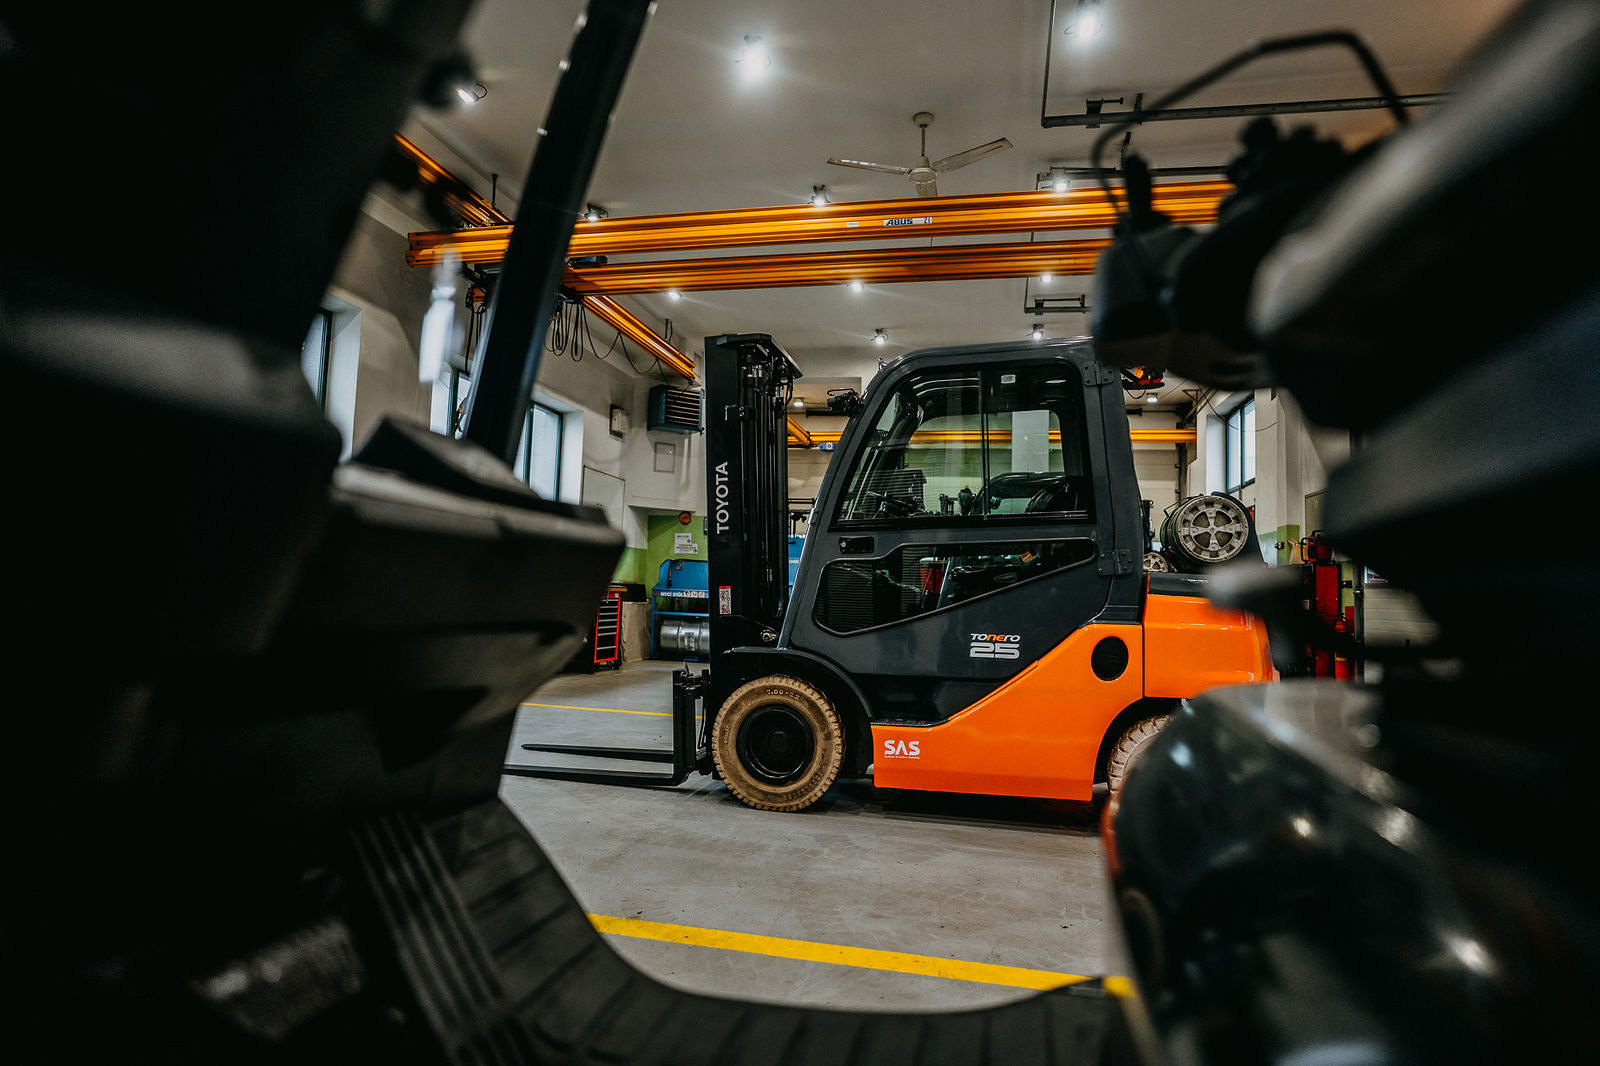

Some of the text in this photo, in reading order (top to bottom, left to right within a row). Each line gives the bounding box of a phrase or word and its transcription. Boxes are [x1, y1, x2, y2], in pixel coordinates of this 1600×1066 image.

[886, 218, 913, 226] ABUS
[715, 461, 730, 534] TOYOTA
[969, 642, 1020, 659] 25
[884, 740, 920, 756] SAS
